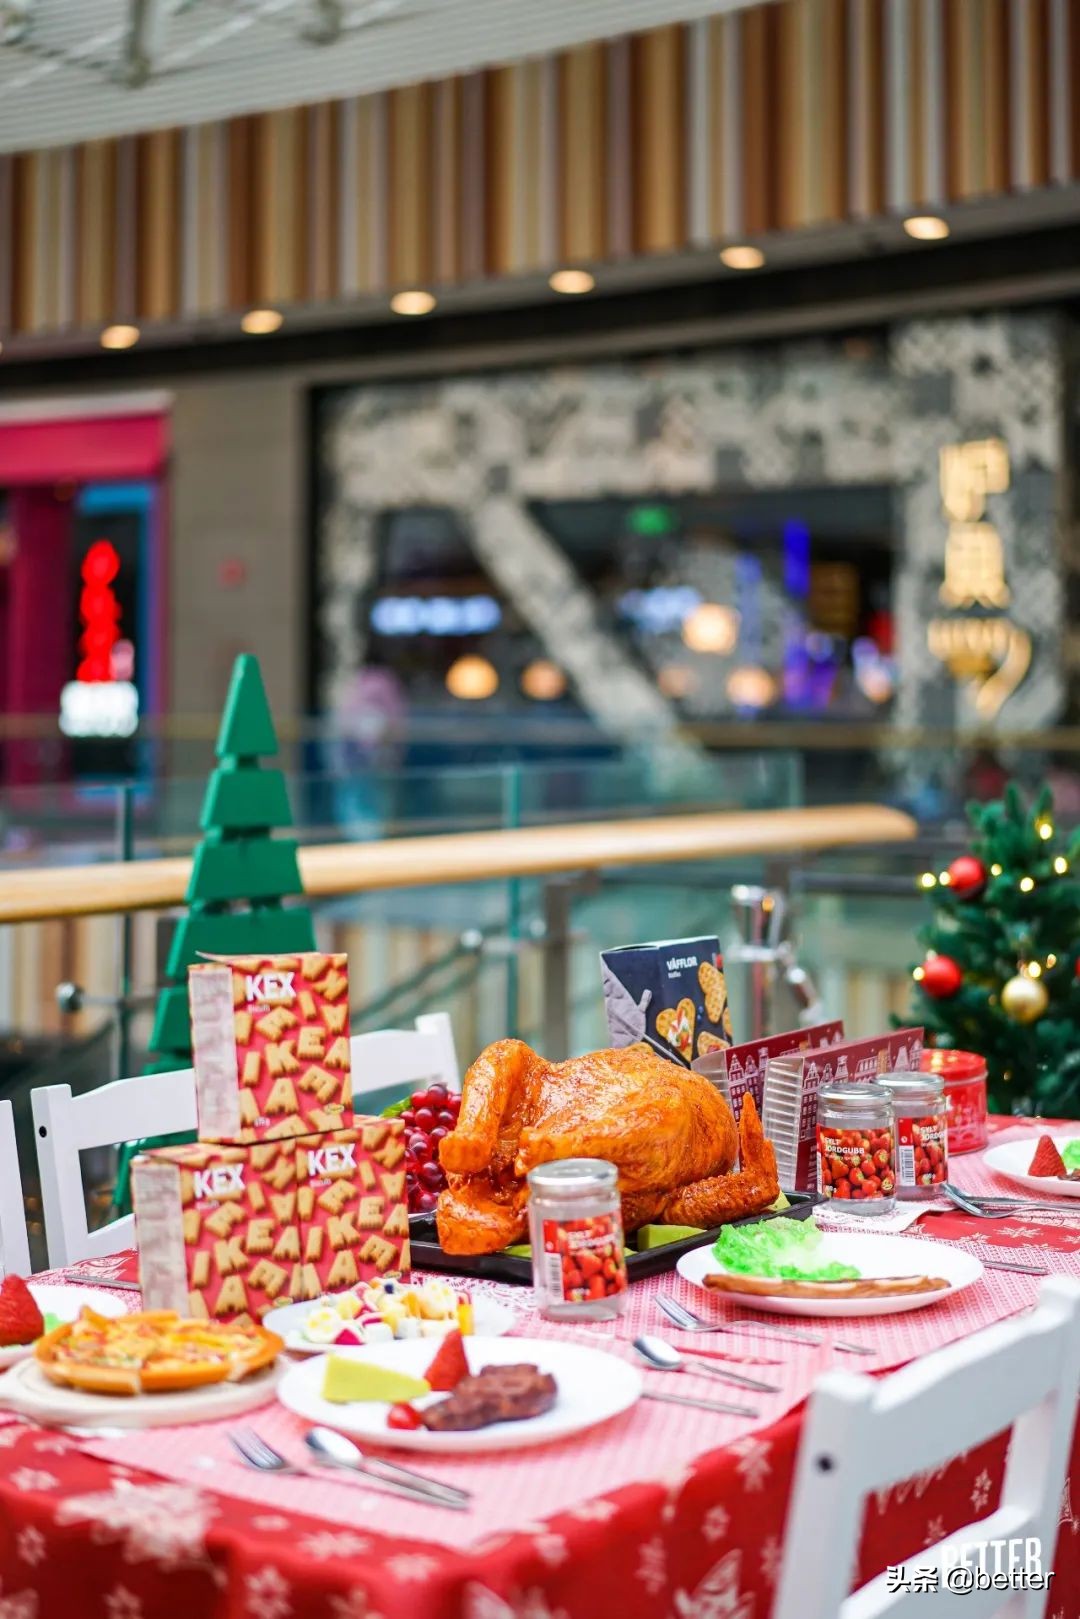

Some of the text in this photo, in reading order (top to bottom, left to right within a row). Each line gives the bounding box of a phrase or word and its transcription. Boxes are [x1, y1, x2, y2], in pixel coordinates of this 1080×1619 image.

[245, 971, 297, 1002] KEX
[307, 1143, 357, 1177] KEX
[194, 1163, 246, 1199] KEX
